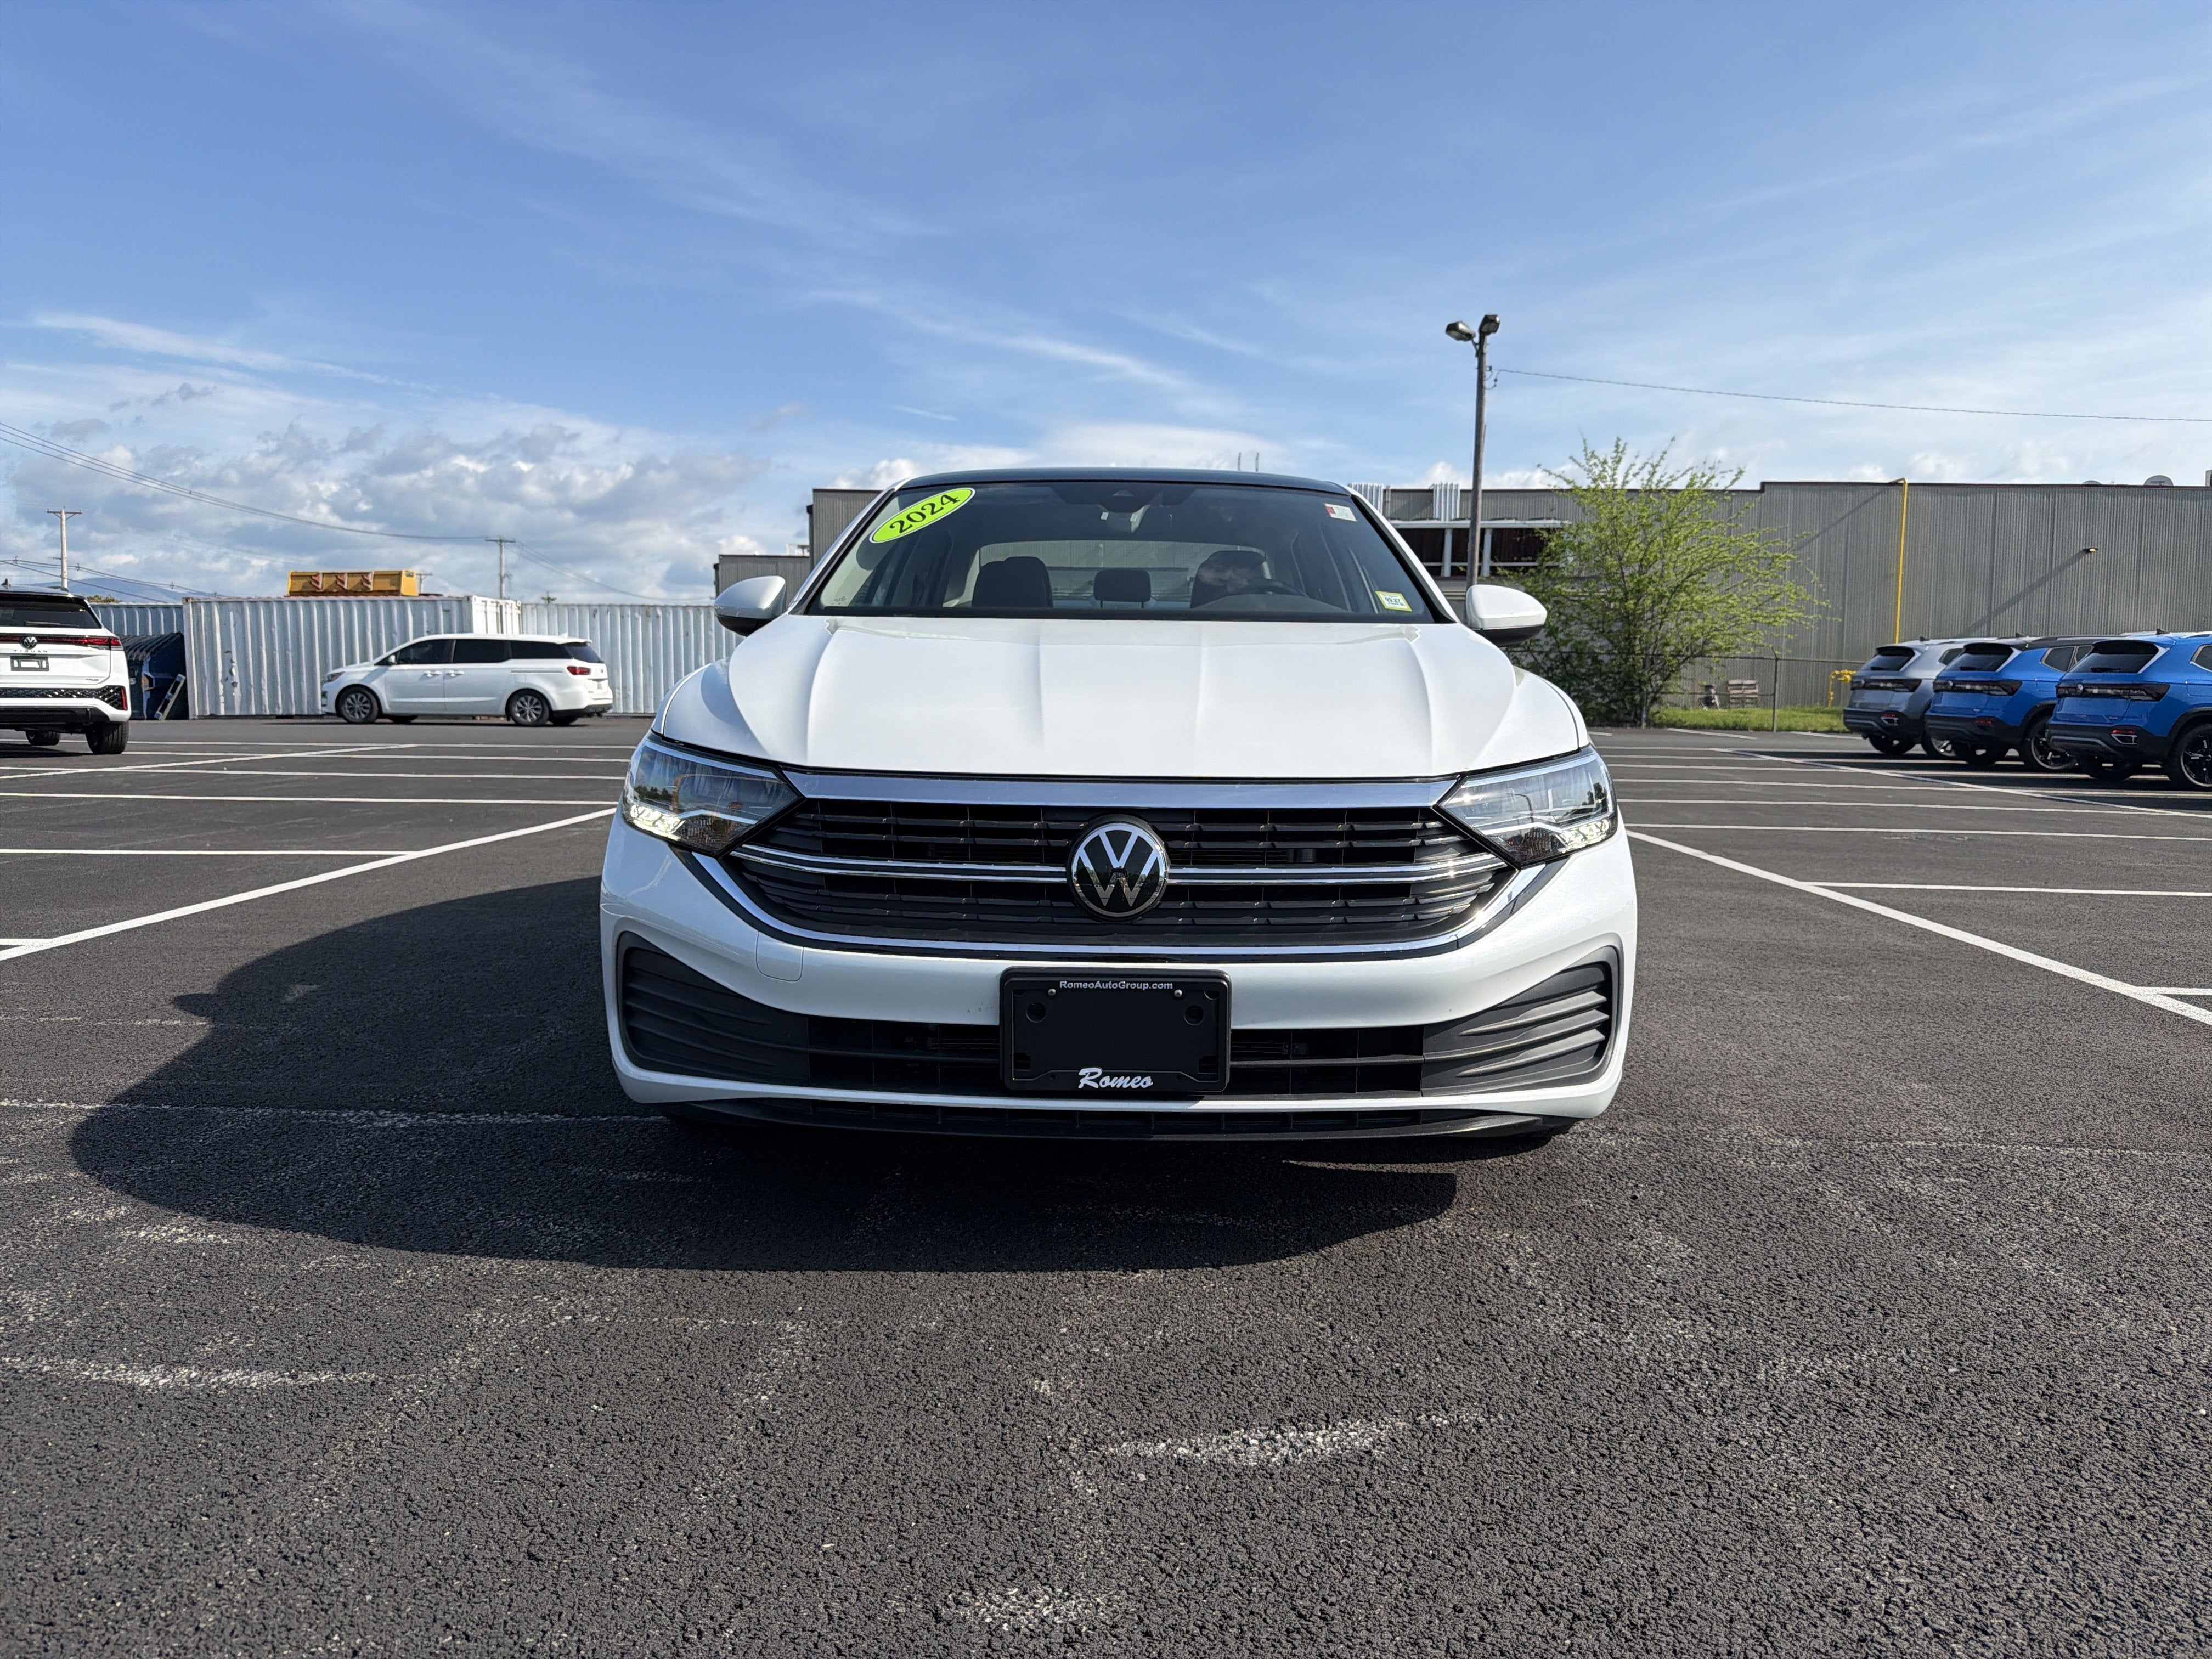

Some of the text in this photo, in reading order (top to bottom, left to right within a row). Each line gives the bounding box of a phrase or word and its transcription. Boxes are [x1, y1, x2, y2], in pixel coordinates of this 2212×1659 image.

[889, 494, 961, 534] 2024
[1059, 980, 1173, 990] RomeoAutoGroup.com
[1078, 1067, 1153, 1089] Romeo
